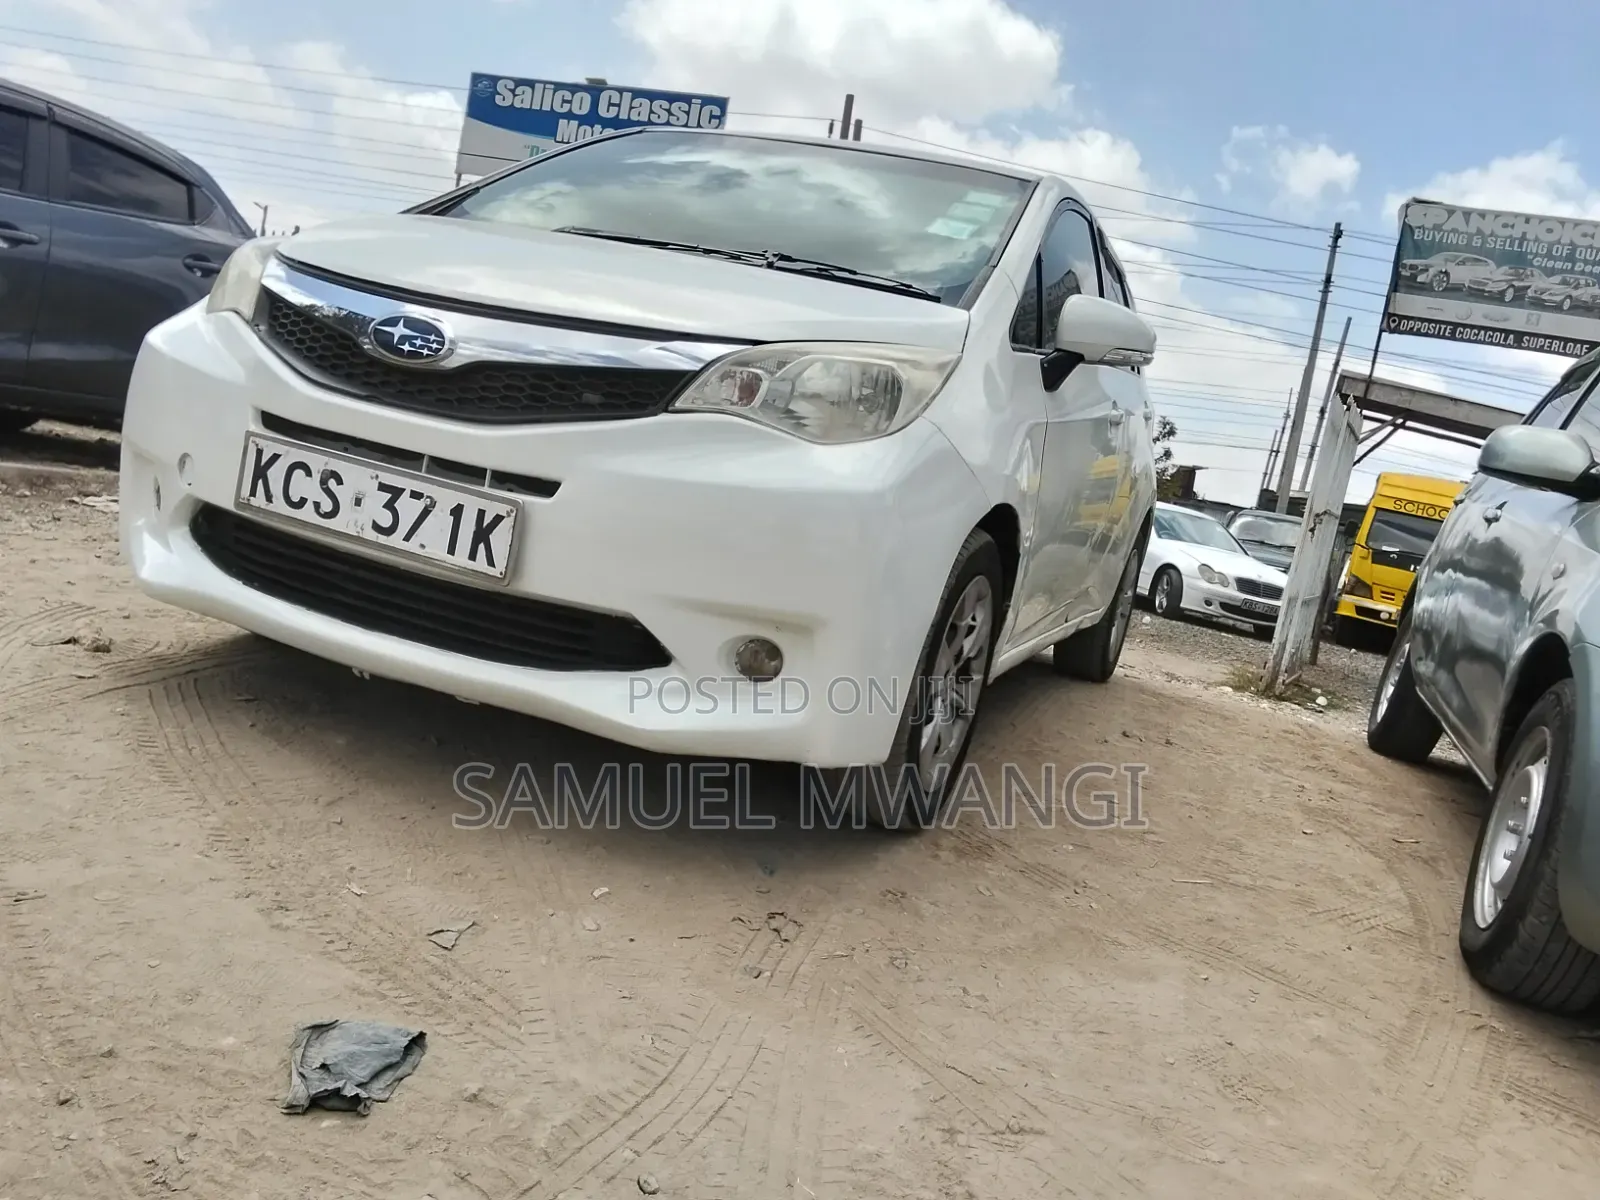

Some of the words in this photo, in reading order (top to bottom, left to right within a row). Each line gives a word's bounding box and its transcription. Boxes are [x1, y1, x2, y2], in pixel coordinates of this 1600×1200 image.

[495, 79, 591, 115] Salico
[598, 90, 721, 129] Classic
[1405, 205, 1600, 248] SPANCHOIC
[1414, 228, 1467, 245] BUYING
[1472, 236, 1482, 247] &
[1486, 237, 1548, 254] SELLING
[1552, 244, 1572, 257] OF
[1400, 319, 1451, 337] OPPOSITE
[1456, 328, 1517, 347] COCACOLA,
[1521, 336, 1590, 356] SUPERLOAF
[249, 448, 345, 520] KCS
[371, 481, 505, 569] 371K
